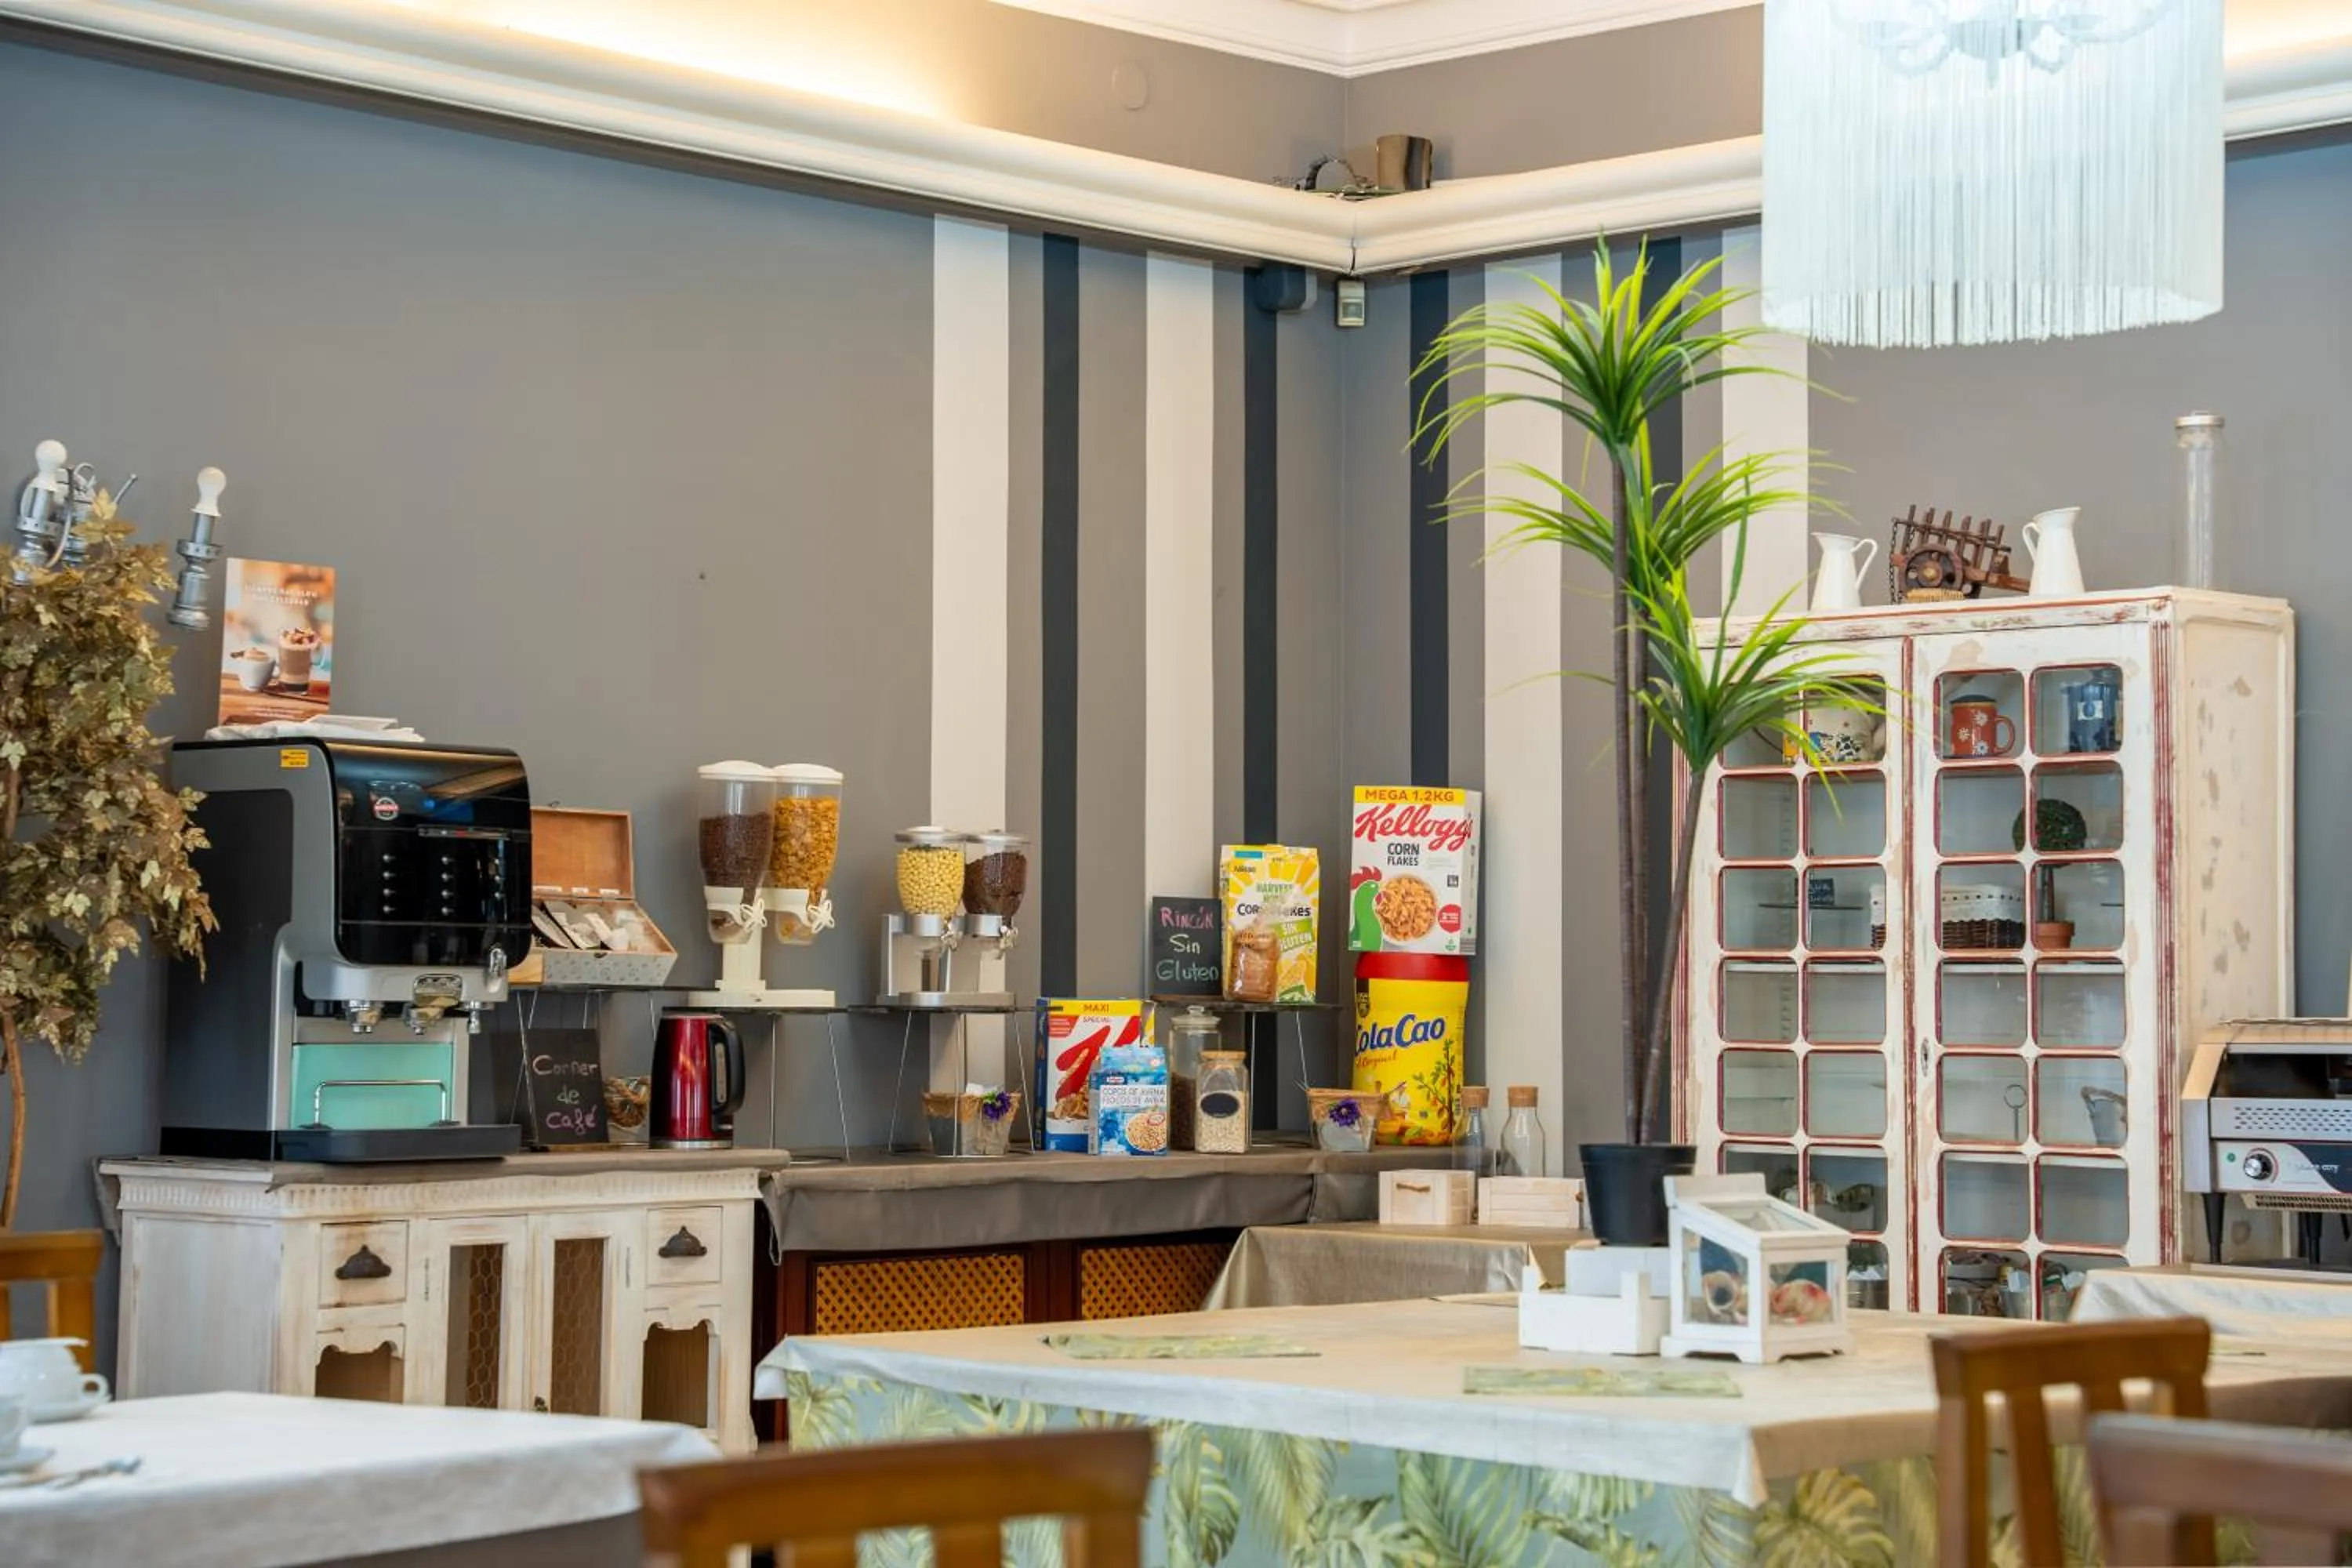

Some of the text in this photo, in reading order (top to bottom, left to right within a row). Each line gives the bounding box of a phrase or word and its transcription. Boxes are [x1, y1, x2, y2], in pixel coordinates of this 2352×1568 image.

[1365, 789, 1454, 802] MEGA 1.2KG
[1387, 843, 1420, 855] CORN
[1387, 856, 1419, 866] FLAKES
[1169, 933, 1200, 954] Sin
[1156, 959, 1219, 982] Gluten
[1083, 1003, 1109, 1013] MAXI
[532, 1054, 598, 1076] Corner
[557, 1084, 580, 1105] de
[546, 1104, 597, 1135] Café
